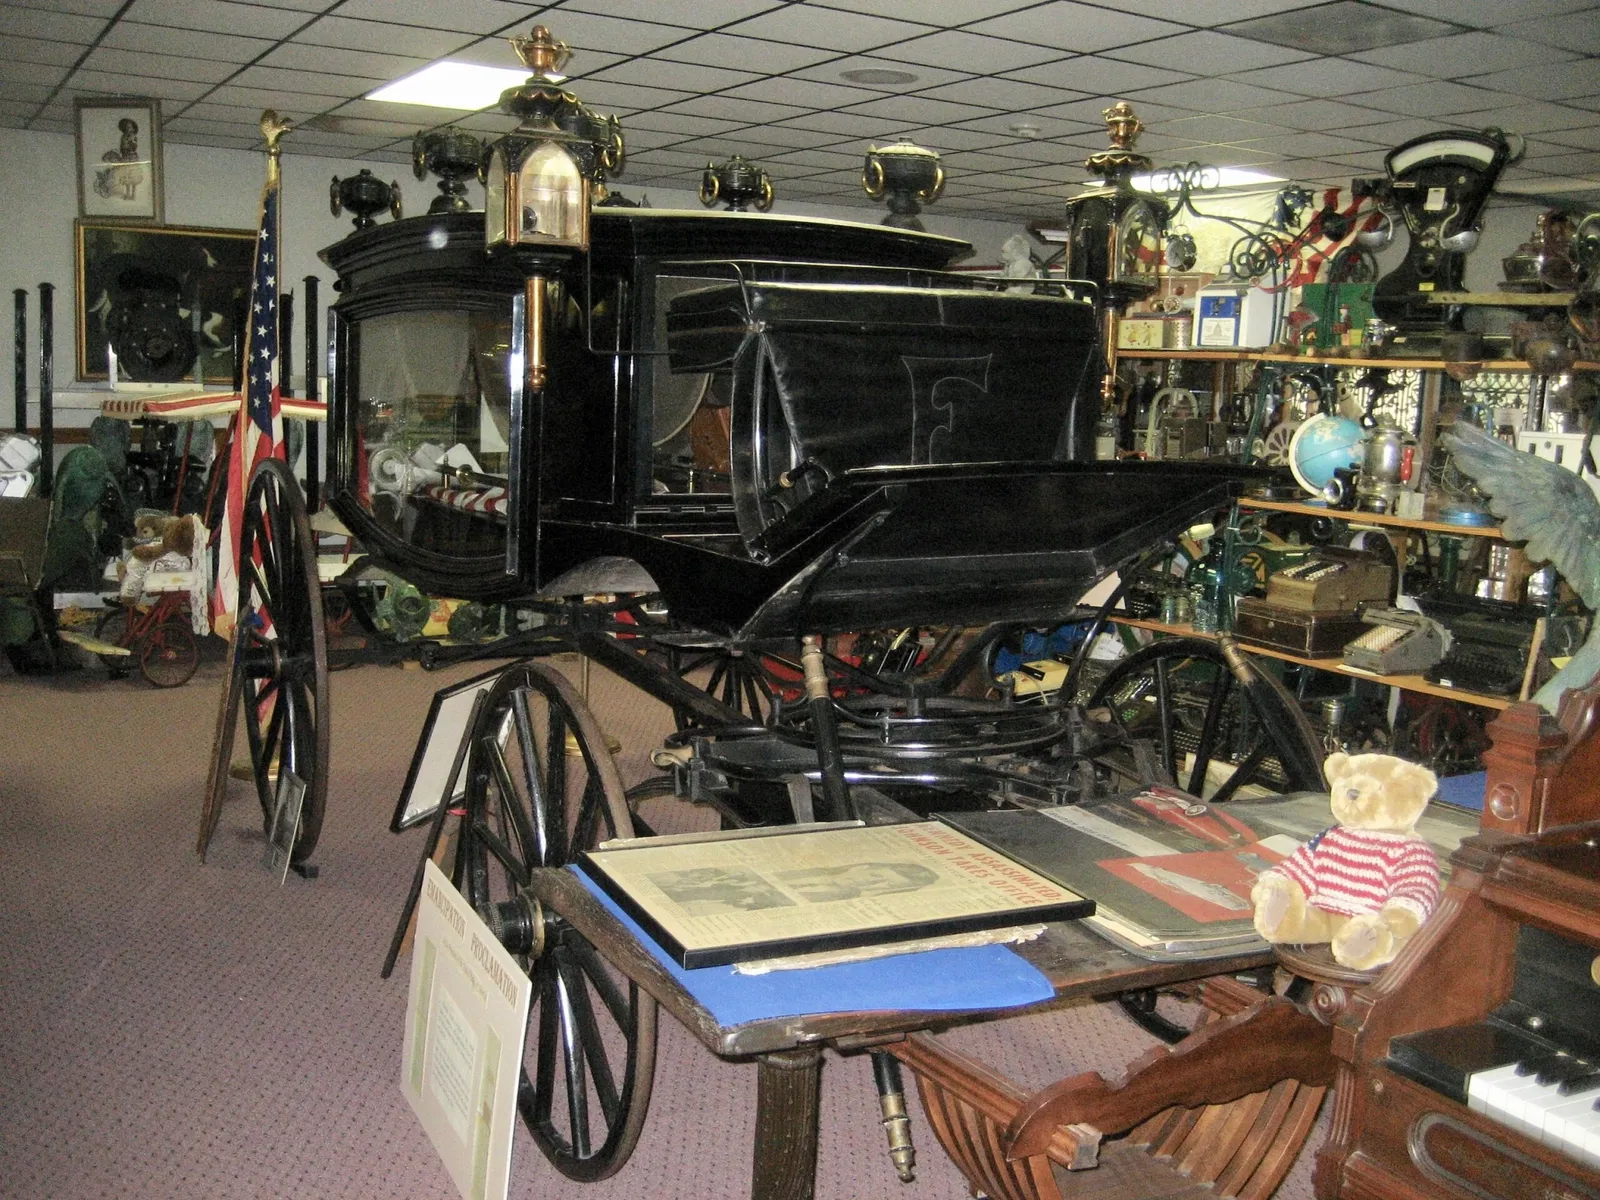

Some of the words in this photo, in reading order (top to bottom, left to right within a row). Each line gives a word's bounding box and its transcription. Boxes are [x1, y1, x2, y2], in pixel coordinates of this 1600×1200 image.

[891, 826, 954, 855] JOHNSON
[946, 856, 994, 879] TAKES
[989, 879, 1042, 905] OFFICE
[426, 878, 468, 938] EMANCIPATION
[470, 932, 519, 1010] PROCLAMATION
